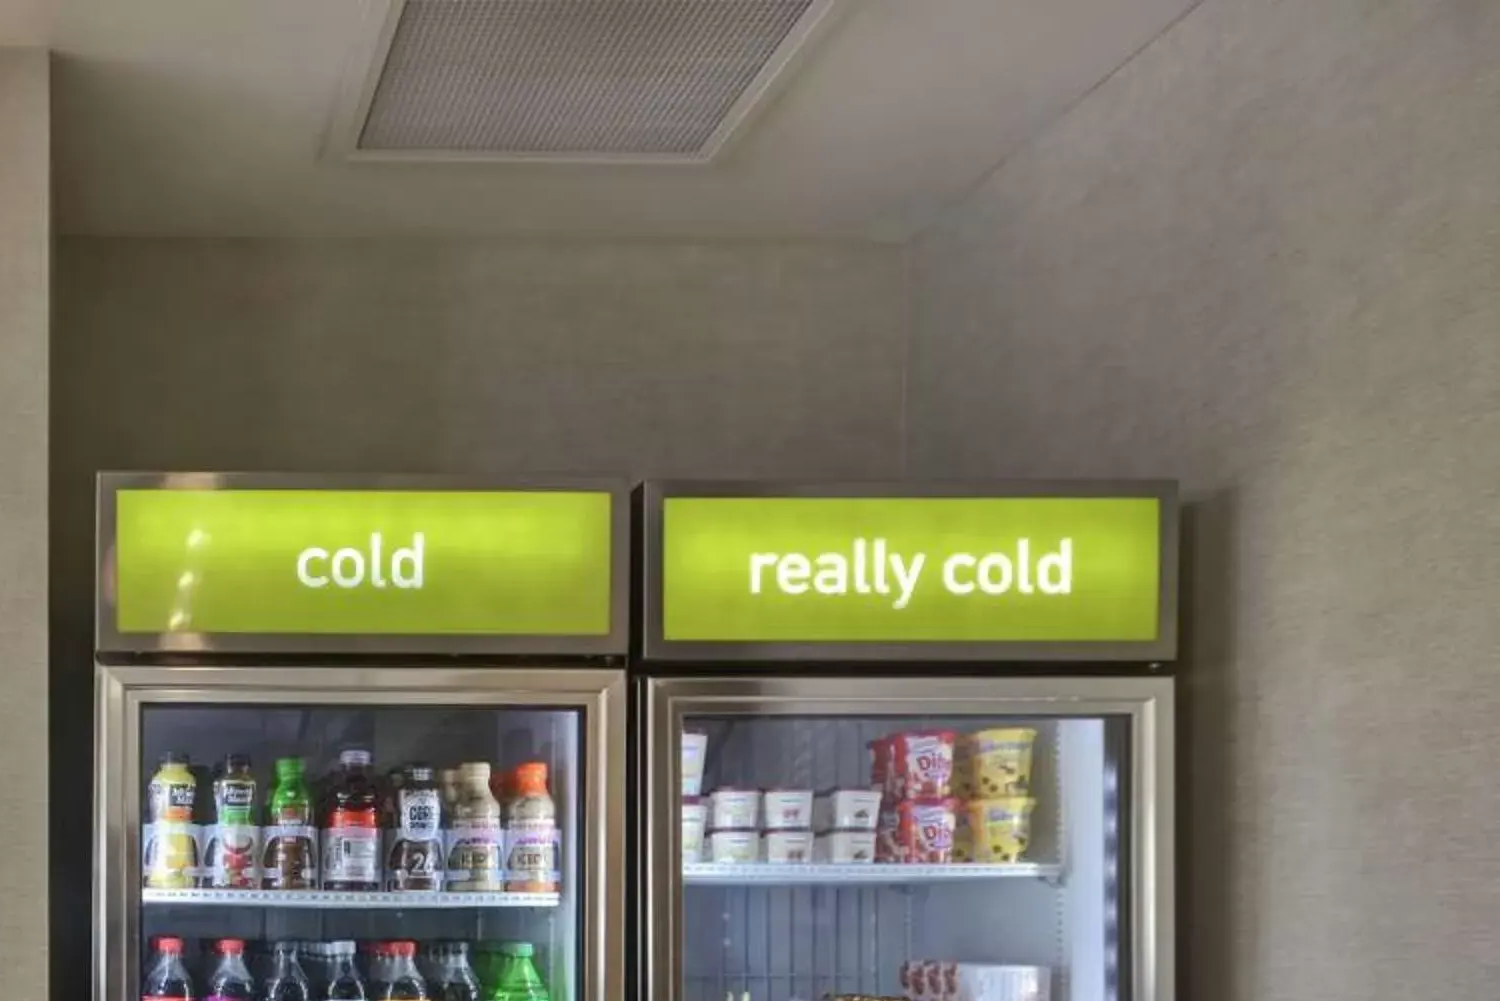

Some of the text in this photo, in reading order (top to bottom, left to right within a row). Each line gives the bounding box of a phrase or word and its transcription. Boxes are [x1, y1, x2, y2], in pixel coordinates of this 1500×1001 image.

[297, 531, 426, 589] cold
[749, 537, 1074, 610] really cold
